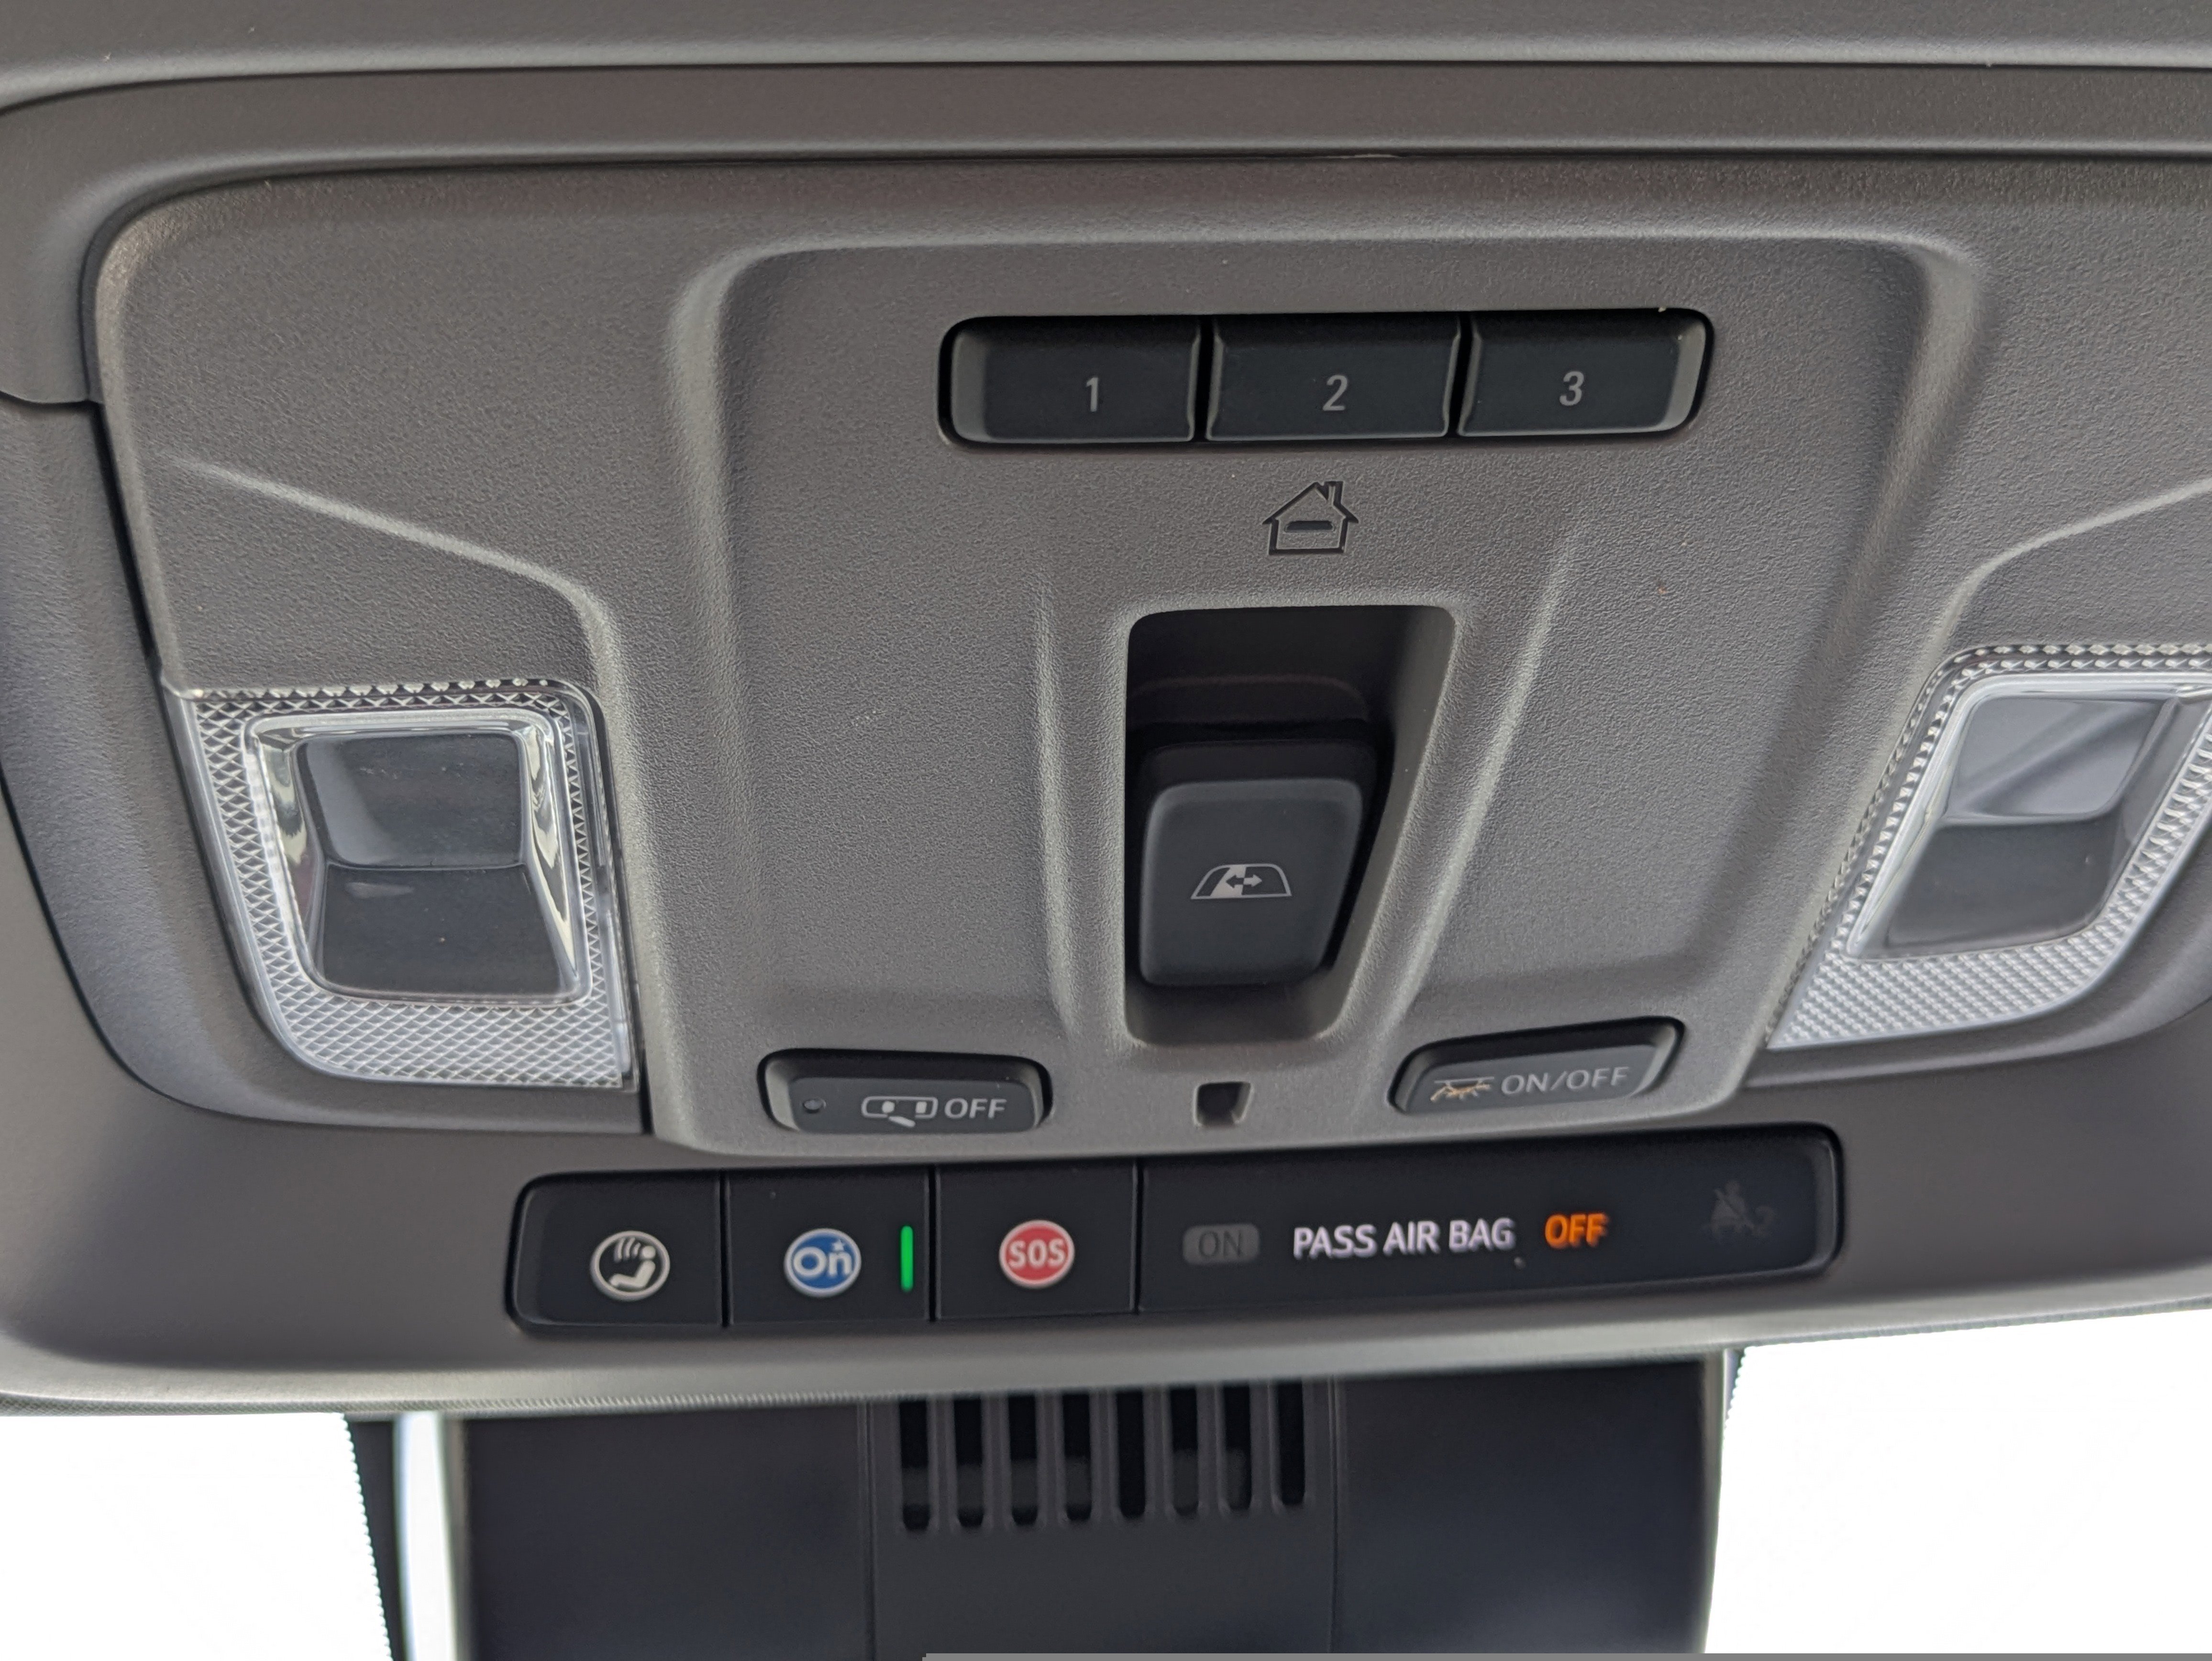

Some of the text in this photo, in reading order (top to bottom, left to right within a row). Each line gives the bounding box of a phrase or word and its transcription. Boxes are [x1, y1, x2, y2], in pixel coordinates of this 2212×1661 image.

[1084, 376, 1100, 413] 1
[1323, 374, 1348, 411] 2
[1559, 371, 1584, 407] 3
[1500, 1066, 1629, 1096] ON/OFF
[944, 1098, 1007, 1119] OFF
[1198, 1230, 1241, 1257] ON
[1293, 1217, 1515, 1260] PASS AIR BAG
[1544, 1212, 1609, 1250] OFF
[793, 1246, 852, 1277] On
[1008, 1238, 1065, 1269] SOS
